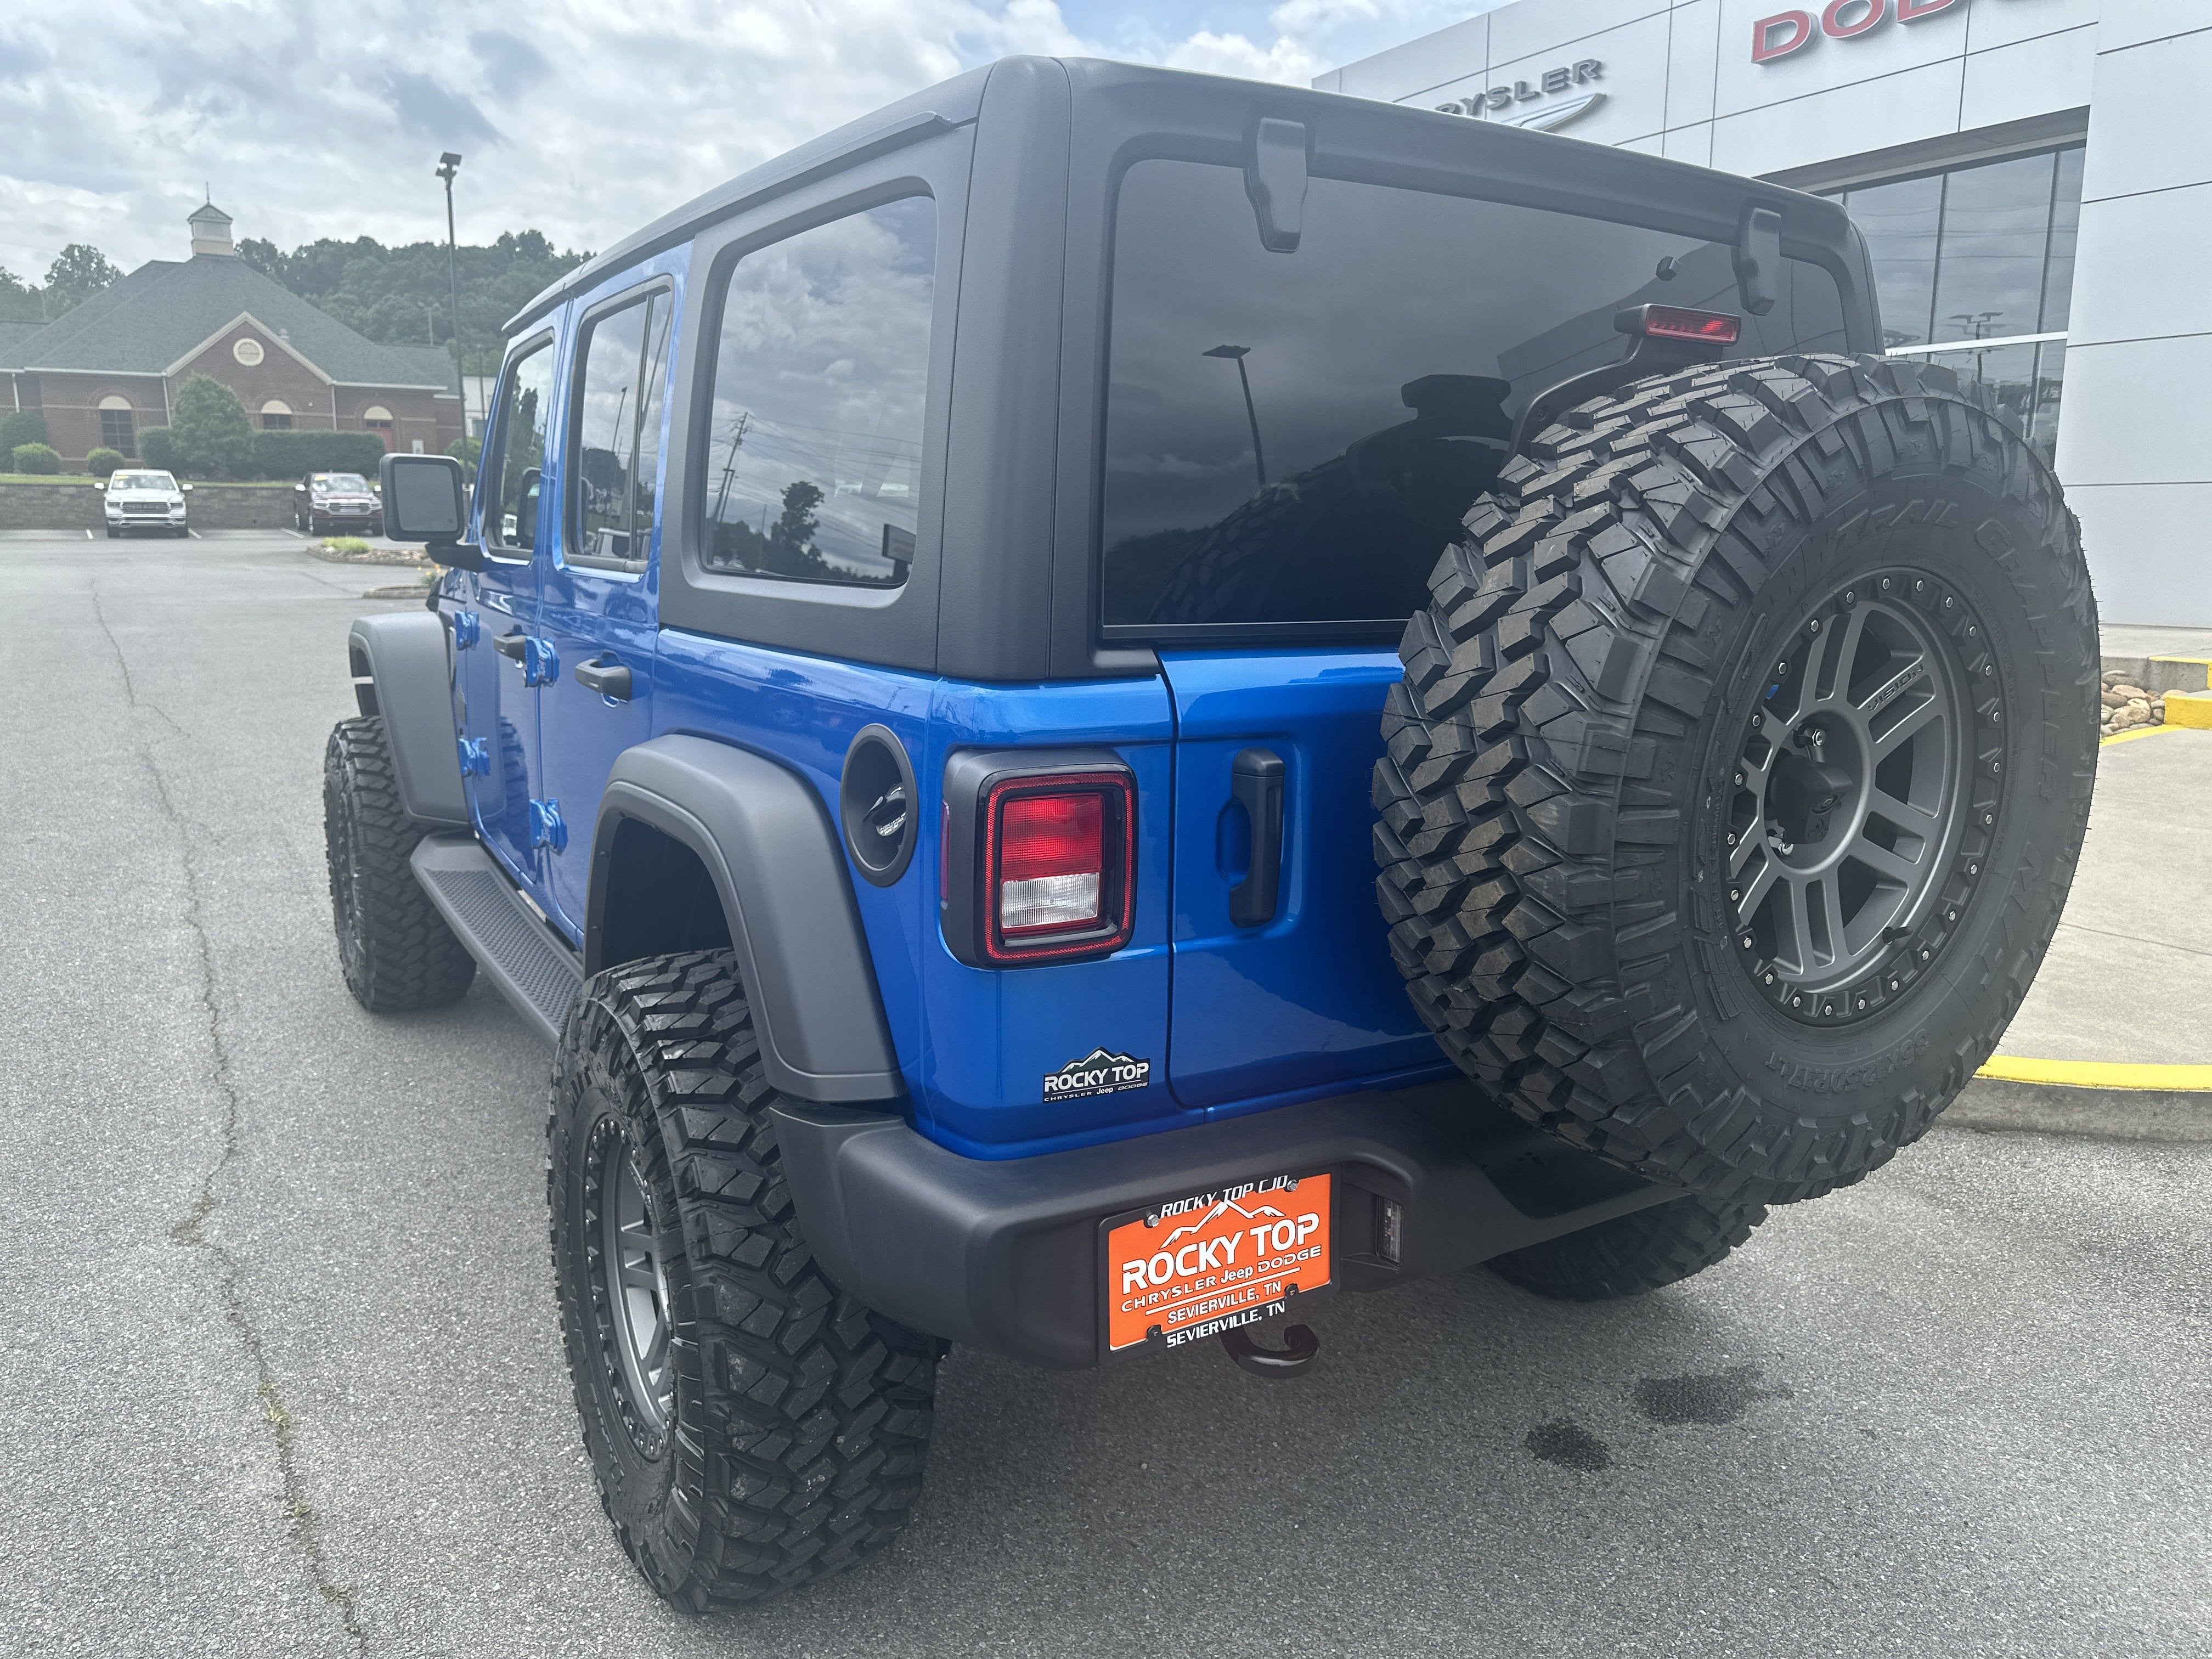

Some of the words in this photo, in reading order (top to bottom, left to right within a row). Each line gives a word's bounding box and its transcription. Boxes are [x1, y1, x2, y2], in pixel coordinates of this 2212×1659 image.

[1867, 662, 1925, 712] VISION
[1044, 1091, 1092, 1102] CHRYSLER
[1097, 1087, 1114, 1095] Jeep
[1118, 1082, 1148, 1091] DODGE
[1045, 1068, 1109, 1092] ROCKY
[1111, 1062, 1149, 1082] TOP
[1160, 1191, 1217, 1218] ROCKY
[1222, 1182, 1254, 1203] TOP
[1122, 1230, 1245, 1295] ROCKY
[1250, 1212, 1320, 1256] TOP
[1121, 1277, 1216, 1312] CHRYSLER
[1220, 1265, 1254, 1284] Jeep
[1257, 1244, 1322, 1272] DODGE
[1167, 1289, 1260, 1325] SEVIERVILLE,
[1263, 1280, 1282, 1295] TN
[1266, 1301, 1285, 1316] TN
